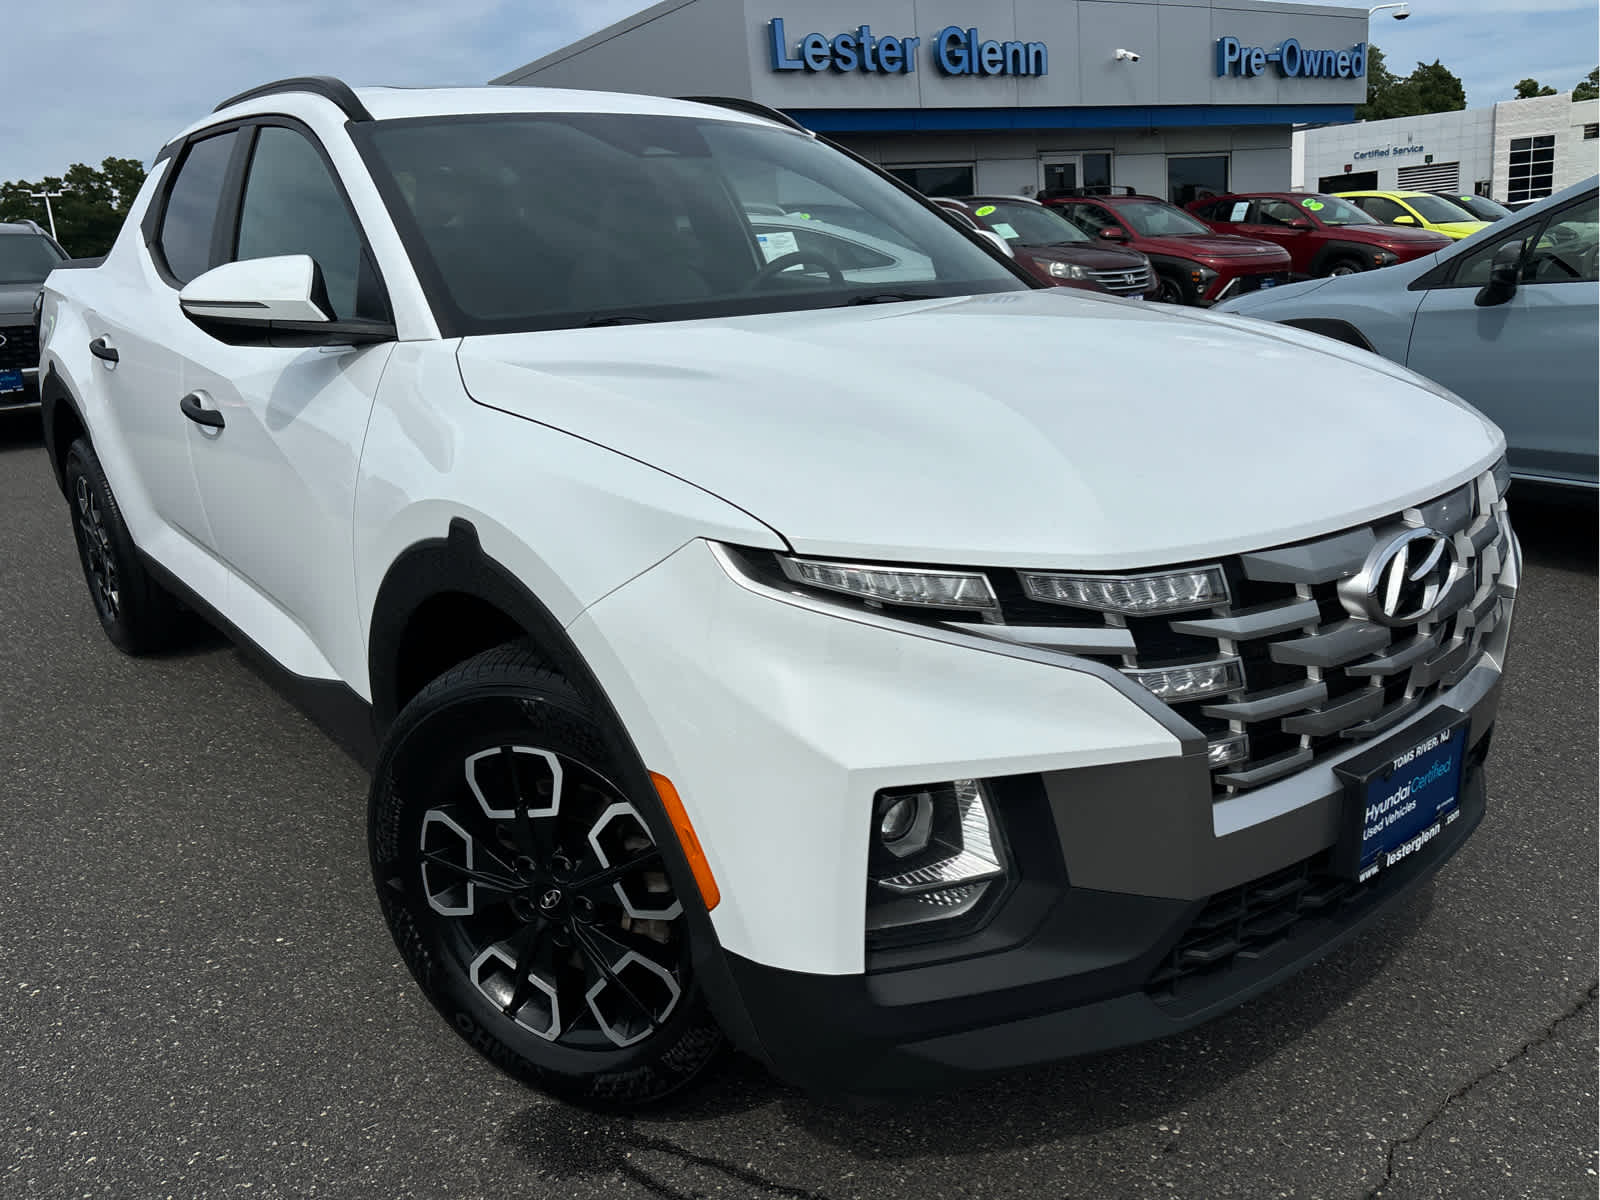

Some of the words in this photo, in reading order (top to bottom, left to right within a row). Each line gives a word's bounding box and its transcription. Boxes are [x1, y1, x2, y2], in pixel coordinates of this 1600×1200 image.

[768, 17, 921, 73] Lester
[933, 25, 1049, 76] Glenn
[1216, 36, 1366, 78] Pre-Owned
[1353, 146, 1390, 160] Certified
[1392, 145, 1424, 155] Service
[1394, 750, 1415, 770] TOMS
[1440, 729, 1451, 743] NJ
[1365, 781, 1412, 824] Hyundai
[1411, 755, 1452, 793] Certified
[1363, 816, 1384, 840] Used
[1385, 800, 1417, 826] Vehicles
[1386, 823, 1441, 867] lesterglenn
